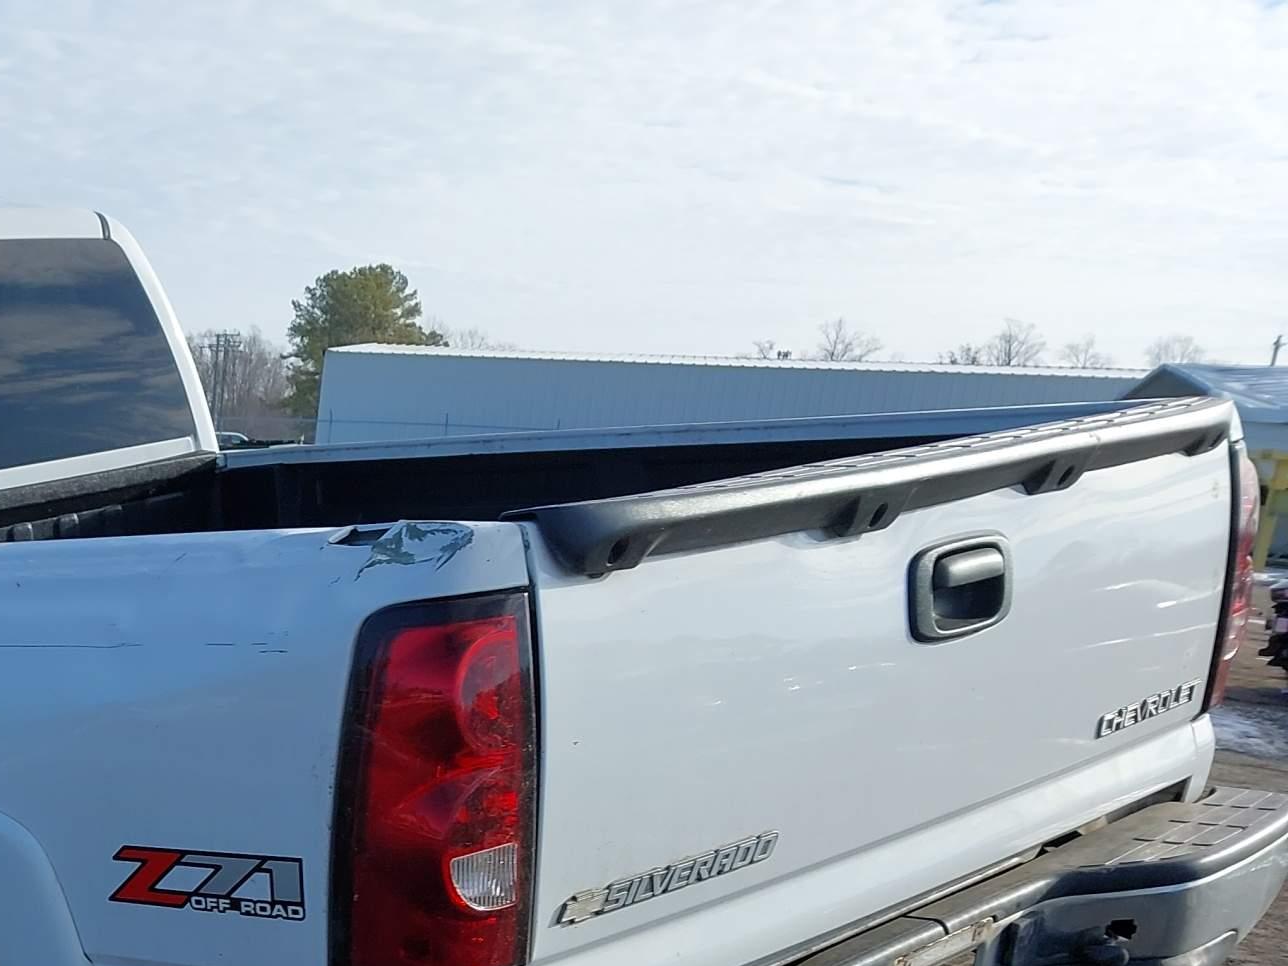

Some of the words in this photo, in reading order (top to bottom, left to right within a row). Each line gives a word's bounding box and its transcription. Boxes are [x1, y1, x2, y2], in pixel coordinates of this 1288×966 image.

[1096, 678, 1201, 738] CHEVROLET
[109, 844, 305, 909] Z71
[601, 830, 779, 912] SILVERADO
[190, 896, 232, 912] OFF
[240, 903, 305, 920] ROAD
